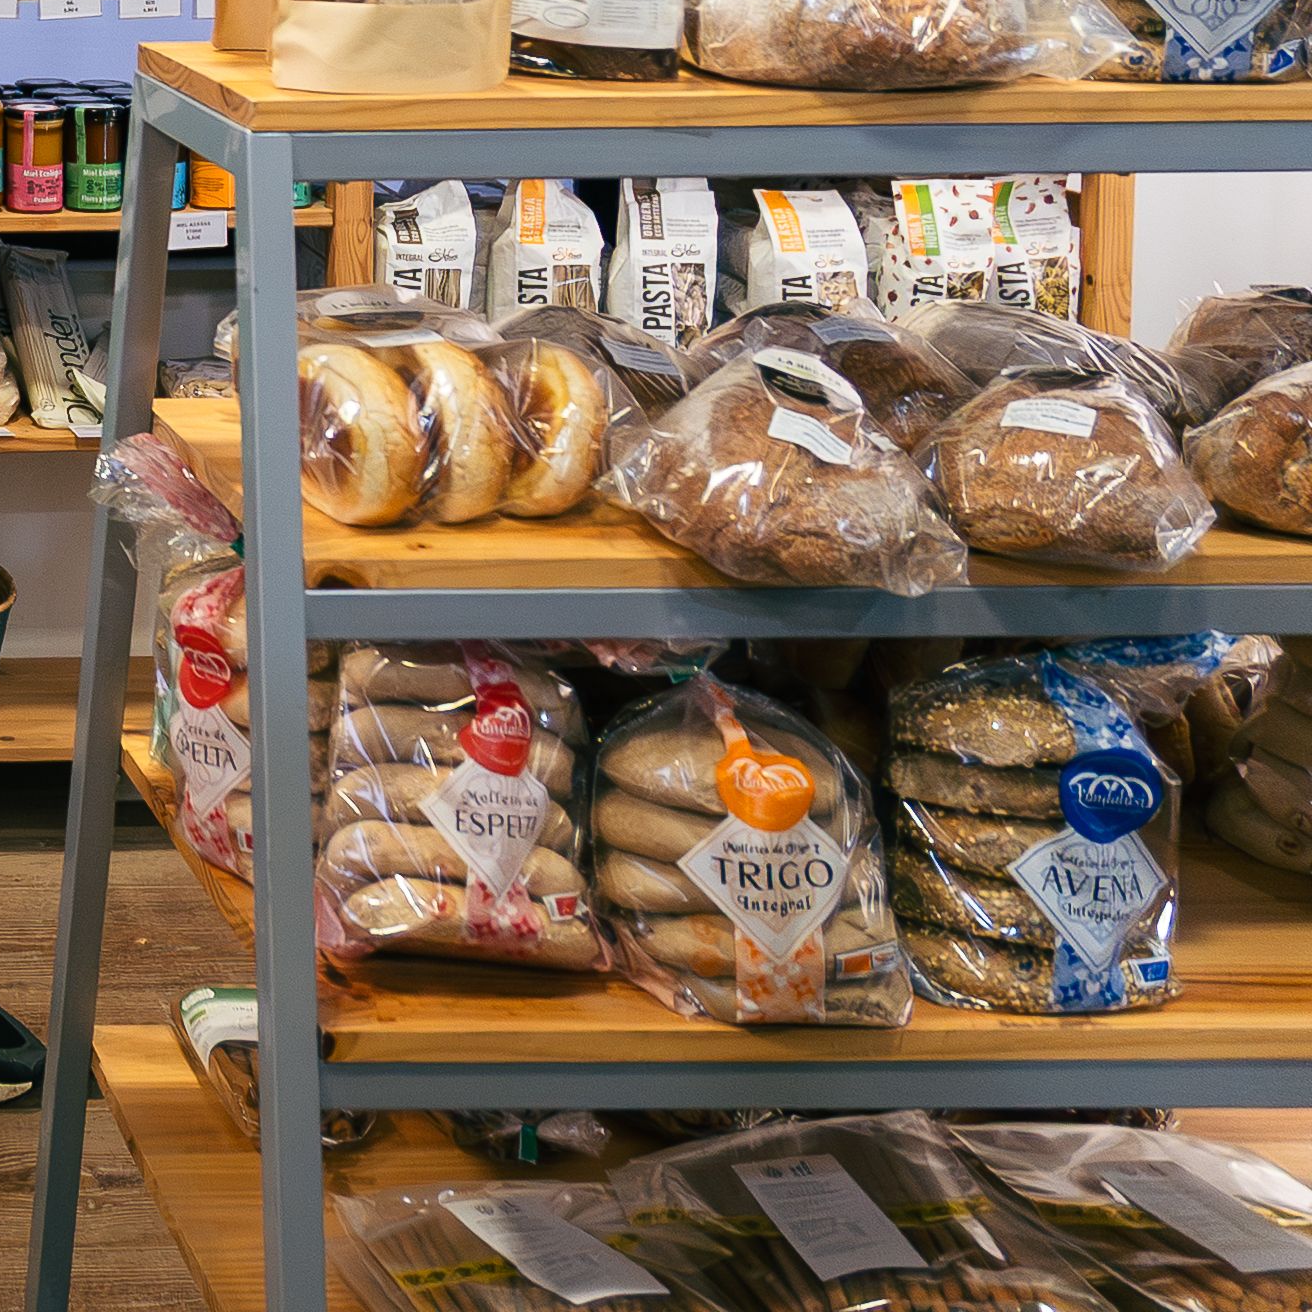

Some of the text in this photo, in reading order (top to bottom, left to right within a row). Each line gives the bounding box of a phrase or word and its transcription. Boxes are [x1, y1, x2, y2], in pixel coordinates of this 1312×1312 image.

[642, 263, 672, 331] PASTA
[711, 855, 834, 891] TRIGO
[1042, 864, 1144, 903] AVENA
[736, 894, 812, 917] Integral
